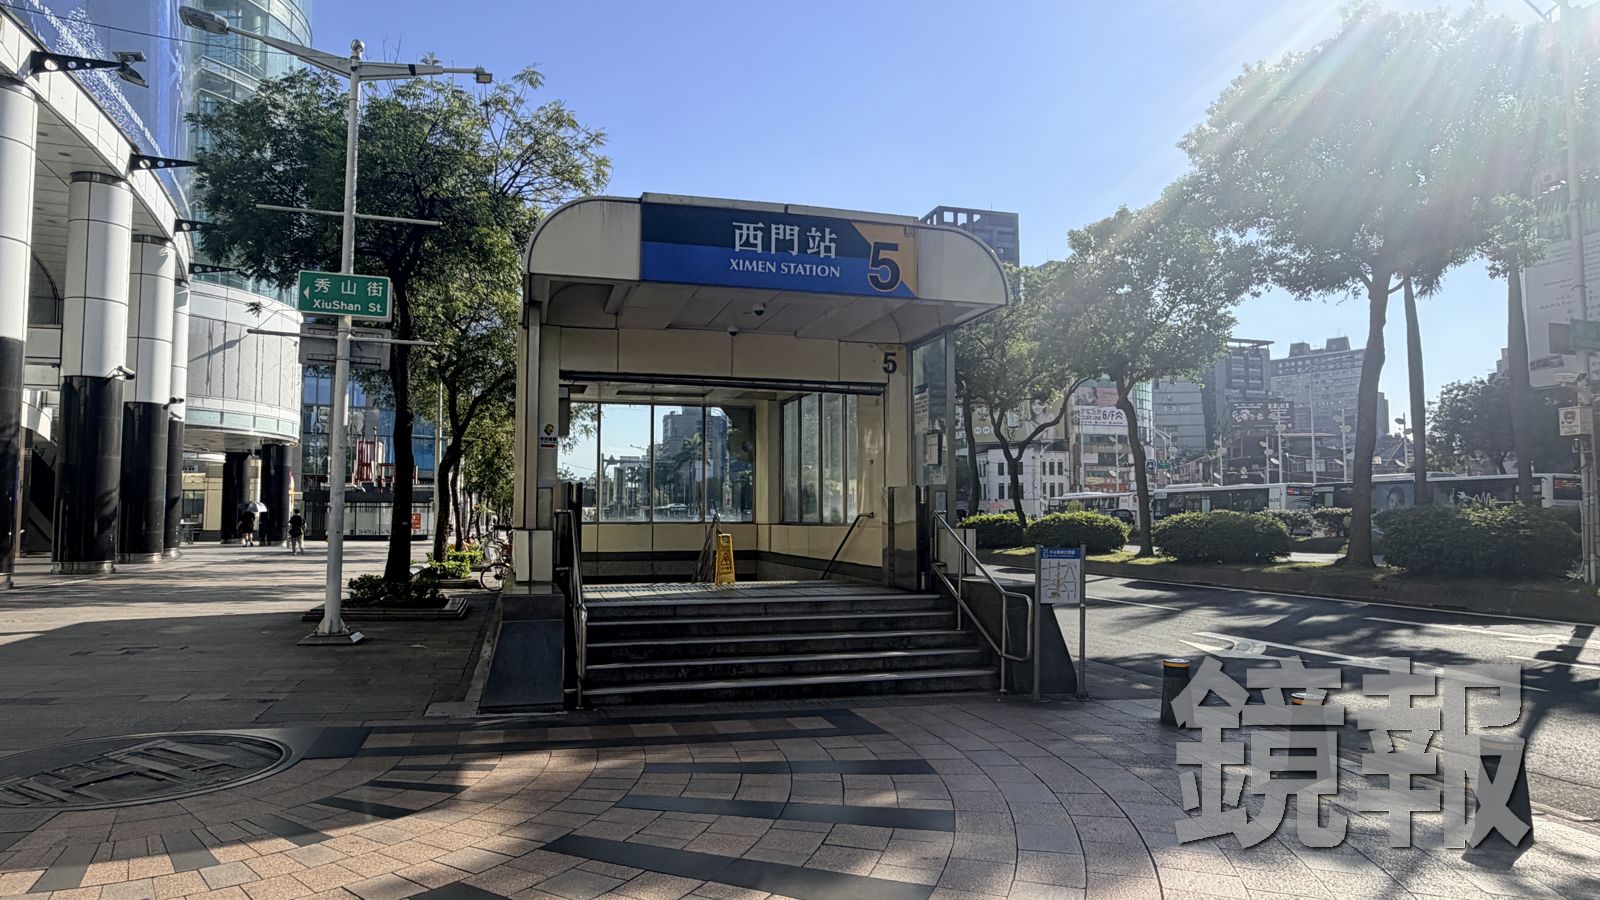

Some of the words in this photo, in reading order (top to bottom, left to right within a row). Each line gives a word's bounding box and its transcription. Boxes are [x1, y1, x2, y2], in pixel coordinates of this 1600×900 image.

[732, 221, 838, 259] 西門站
[729, 258, 777, 273] XIMEN
[780, 262, 841, 278] STATION
[867, 241, 901, 293] 5
[314, 278, 384, 297] 秀山街
[313, 299, 362, 312] XiuShan
[883, 351, 897, 374] 5
